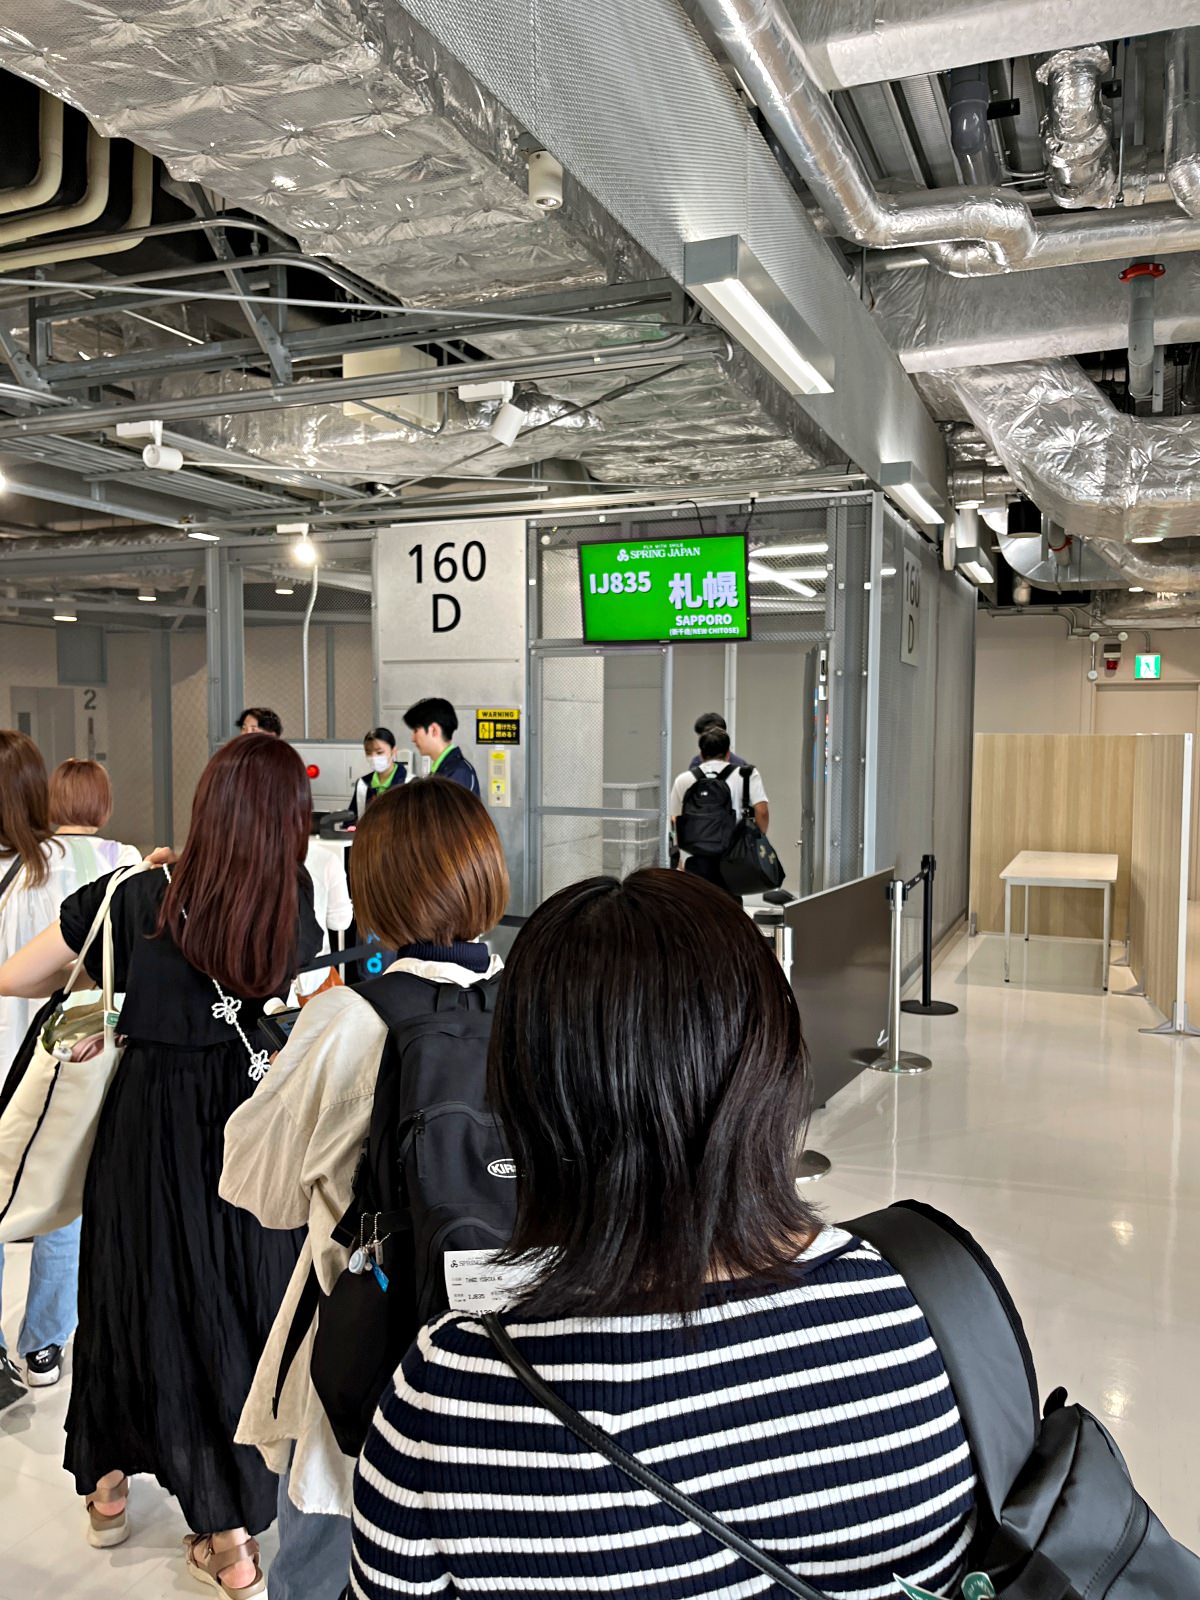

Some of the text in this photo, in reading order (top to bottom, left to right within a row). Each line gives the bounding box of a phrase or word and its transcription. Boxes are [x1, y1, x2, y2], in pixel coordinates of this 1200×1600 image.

[408, 541, 486, 583] 160
[630, 547, 701, 560] SPRING JAPAN
[589, 572, 651, 594] IJ835
[669, 571, 739, 609] 札幌
[432, 594, 461, 633] D
[676, 614, 732, 626] SAPPORO
[907, 614, 915, 654] D
[84, 689, 97, 710] 2
